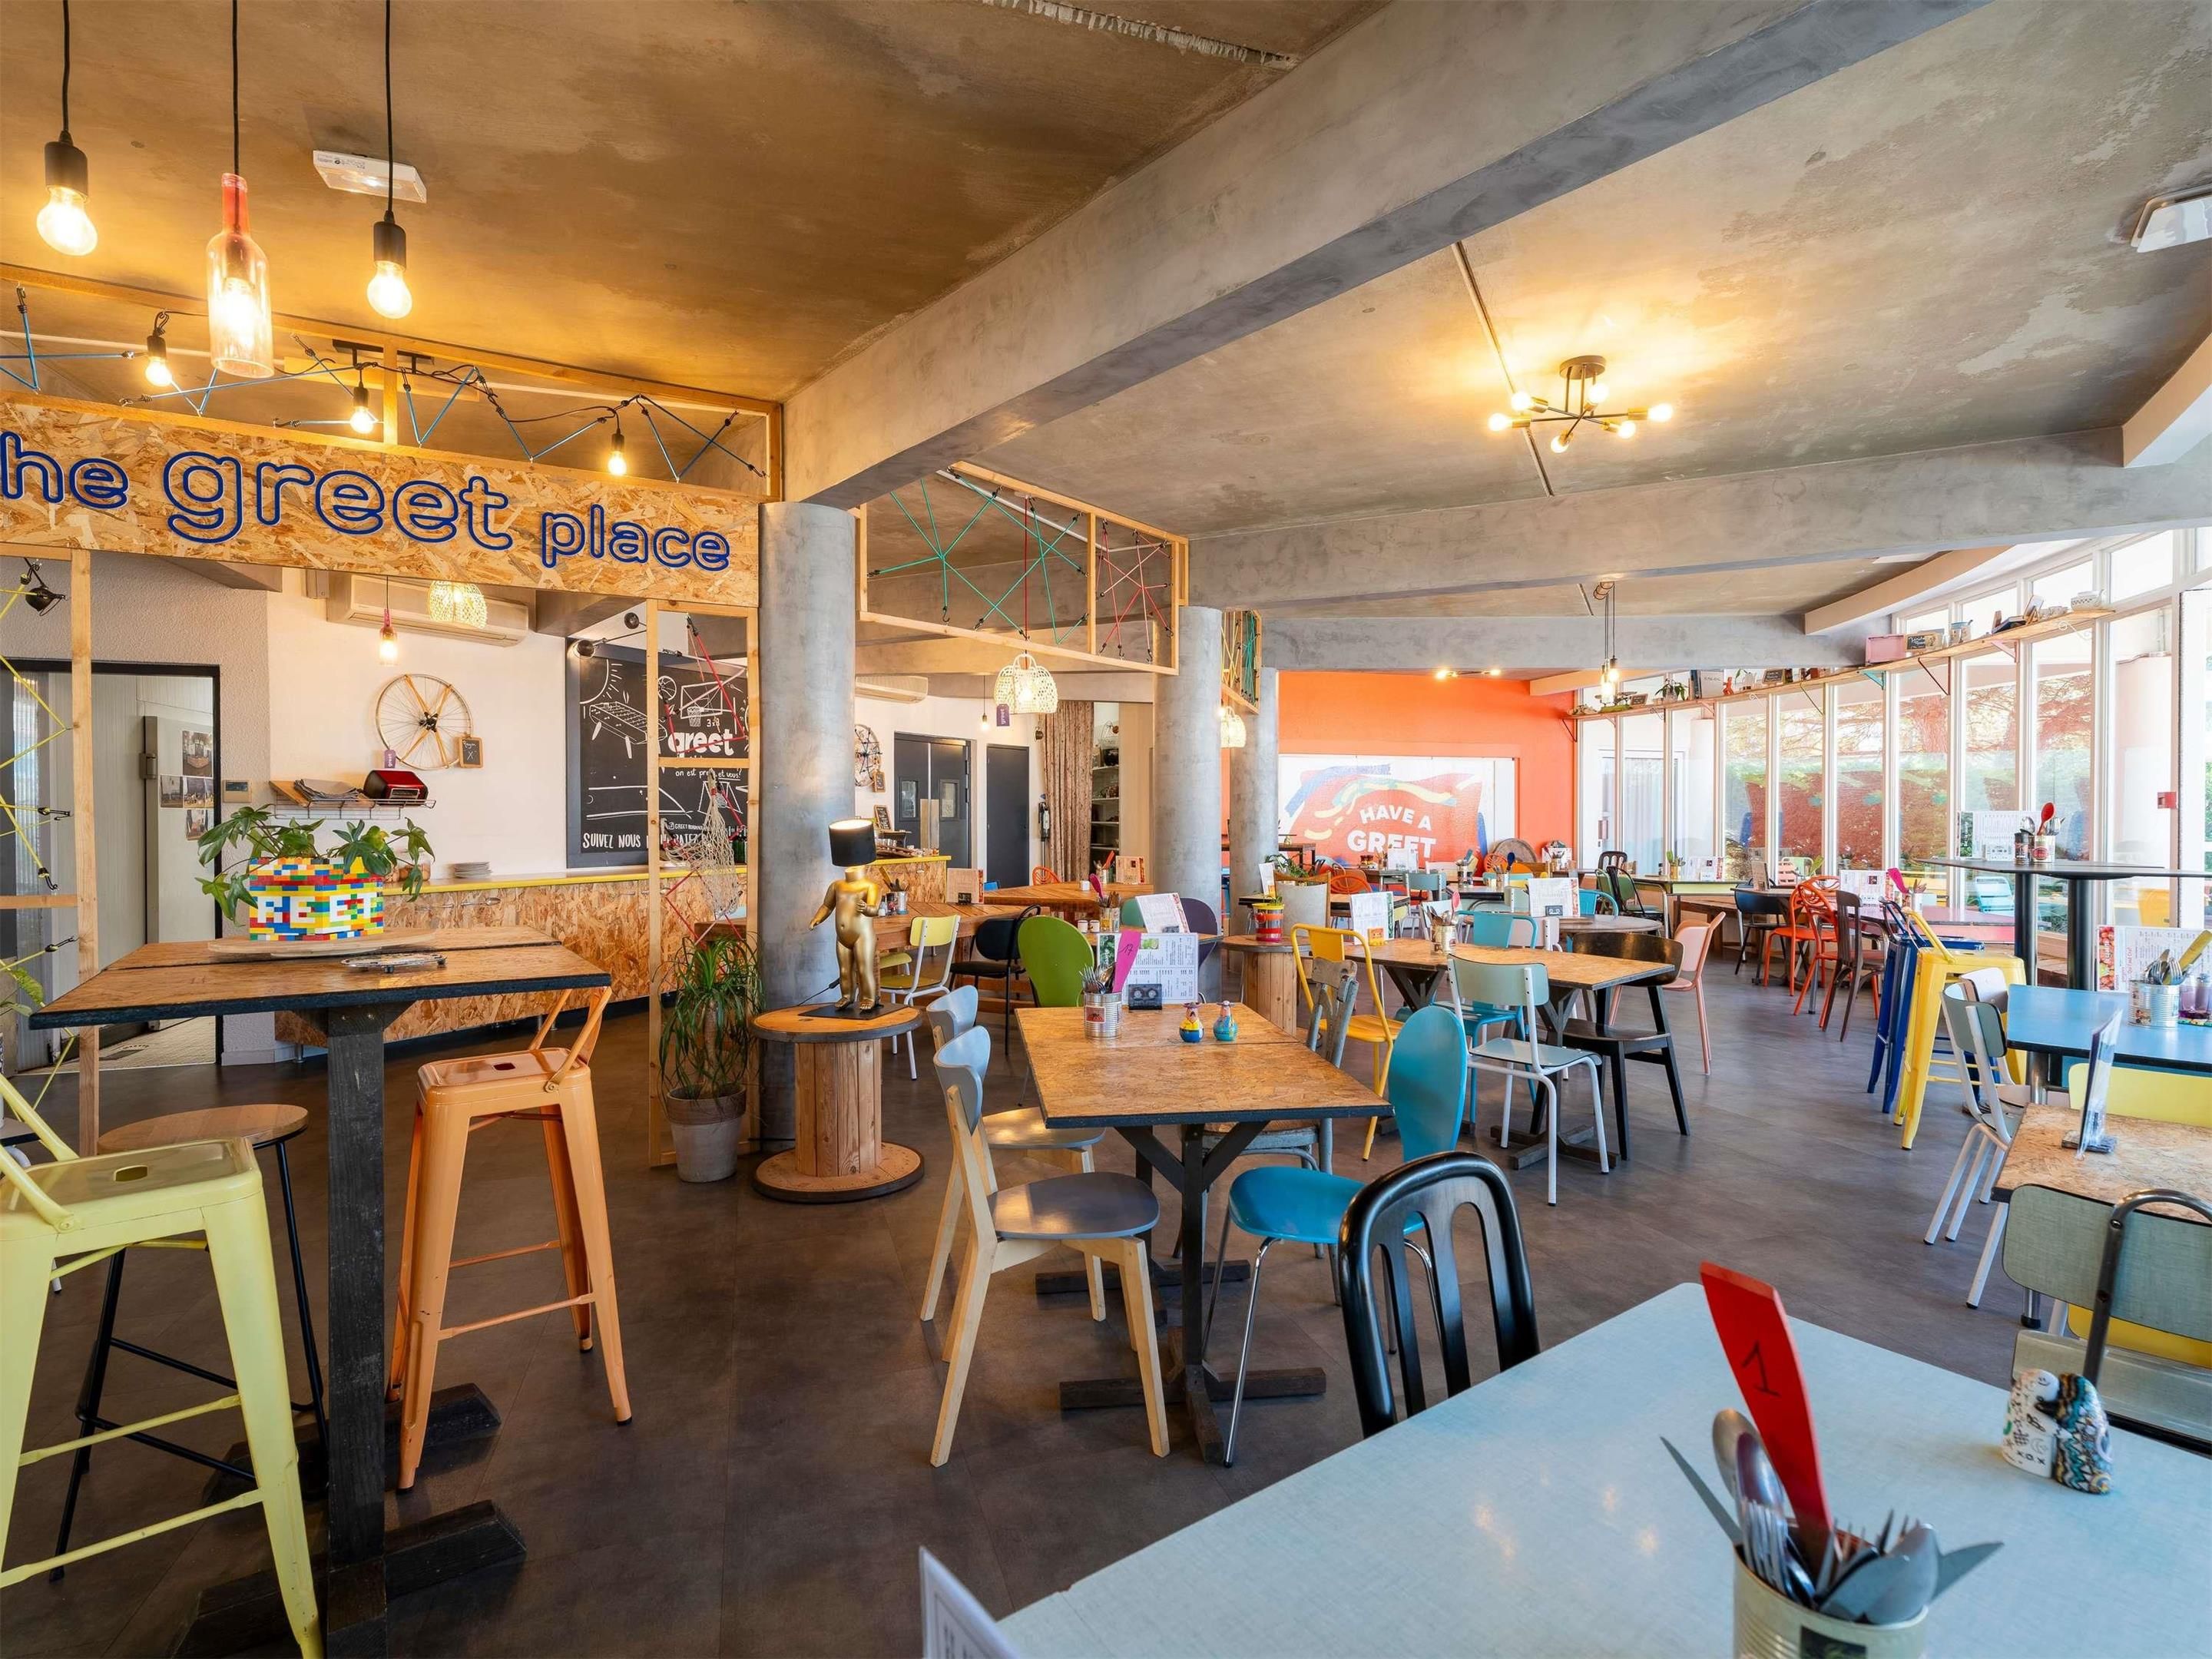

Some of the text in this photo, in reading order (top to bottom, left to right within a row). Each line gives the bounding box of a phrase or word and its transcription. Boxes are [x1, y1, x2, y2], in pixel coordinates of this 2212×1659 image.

[163, 450, 514, 551] greet
[541, 504, 731, 571] place
[667, 729, 734, 758] greet
[1359, 804, 1432, 831] HAVE A
[582, 833, 614, 849] SUIVEZ
[618, 834, 641, 848] NOUS
[1347, 830, 1436, 858] GREET
[1118, 944, 1133, 956] 17
[1740, 1339, 1781, 1397] 1
